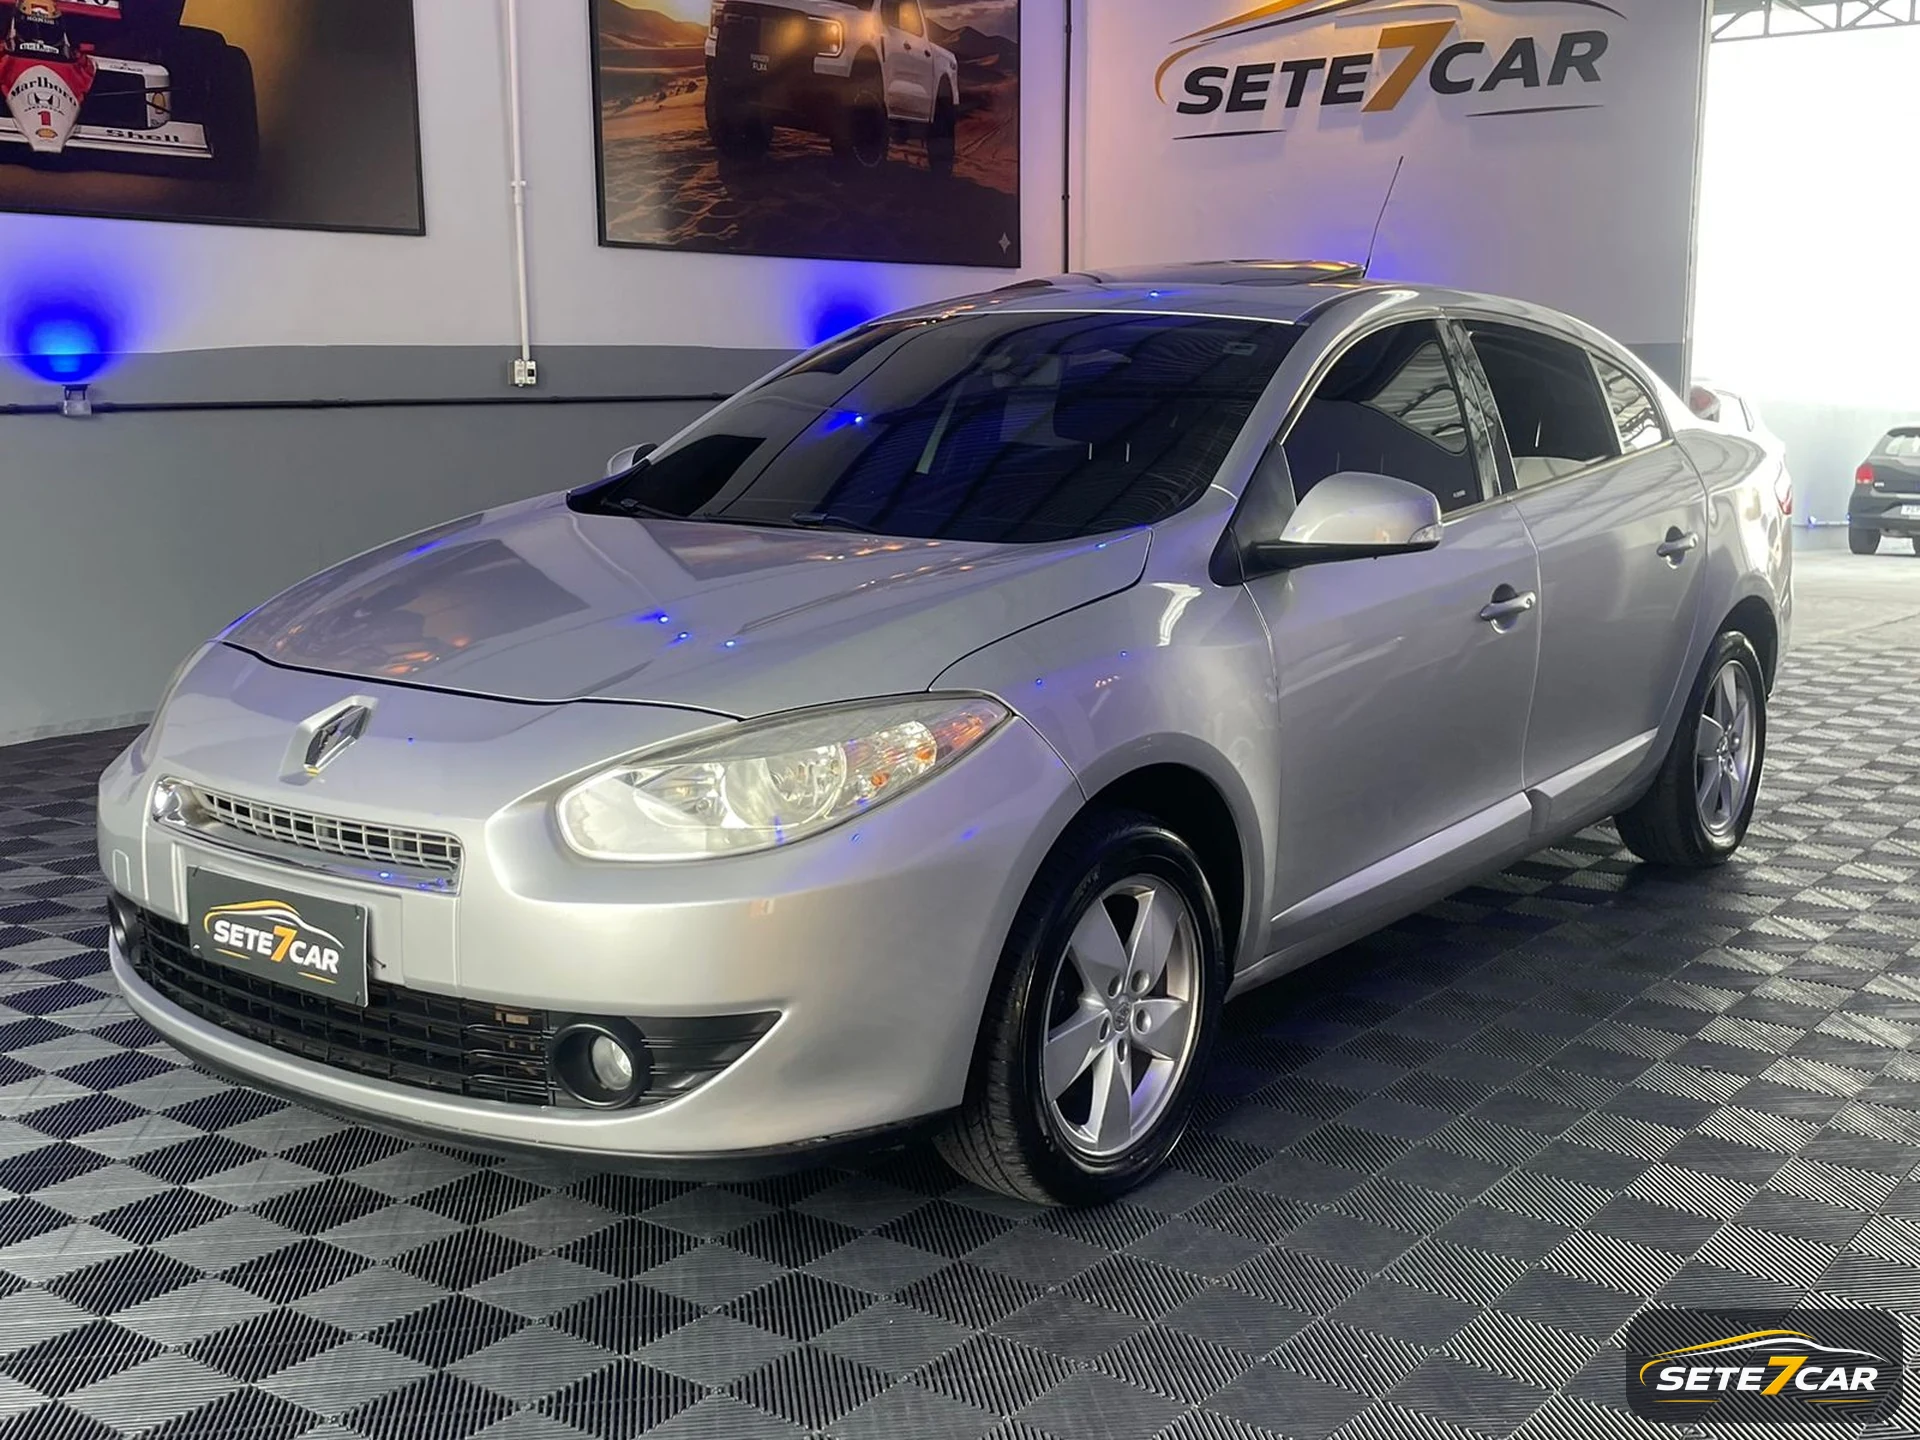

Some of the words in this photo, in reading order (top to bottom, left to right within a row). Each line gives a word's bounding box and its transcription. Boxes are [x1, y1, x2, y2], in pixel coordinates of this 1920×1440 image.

[1176, 20, 1609, 115] SETE7CAR
[11, 76, 77, 107] Marlboro
[37, 110, 51, 126] 1
[106, 129, 180, 143] Shell
[213, 919, 340, 974] SETE7CAR
